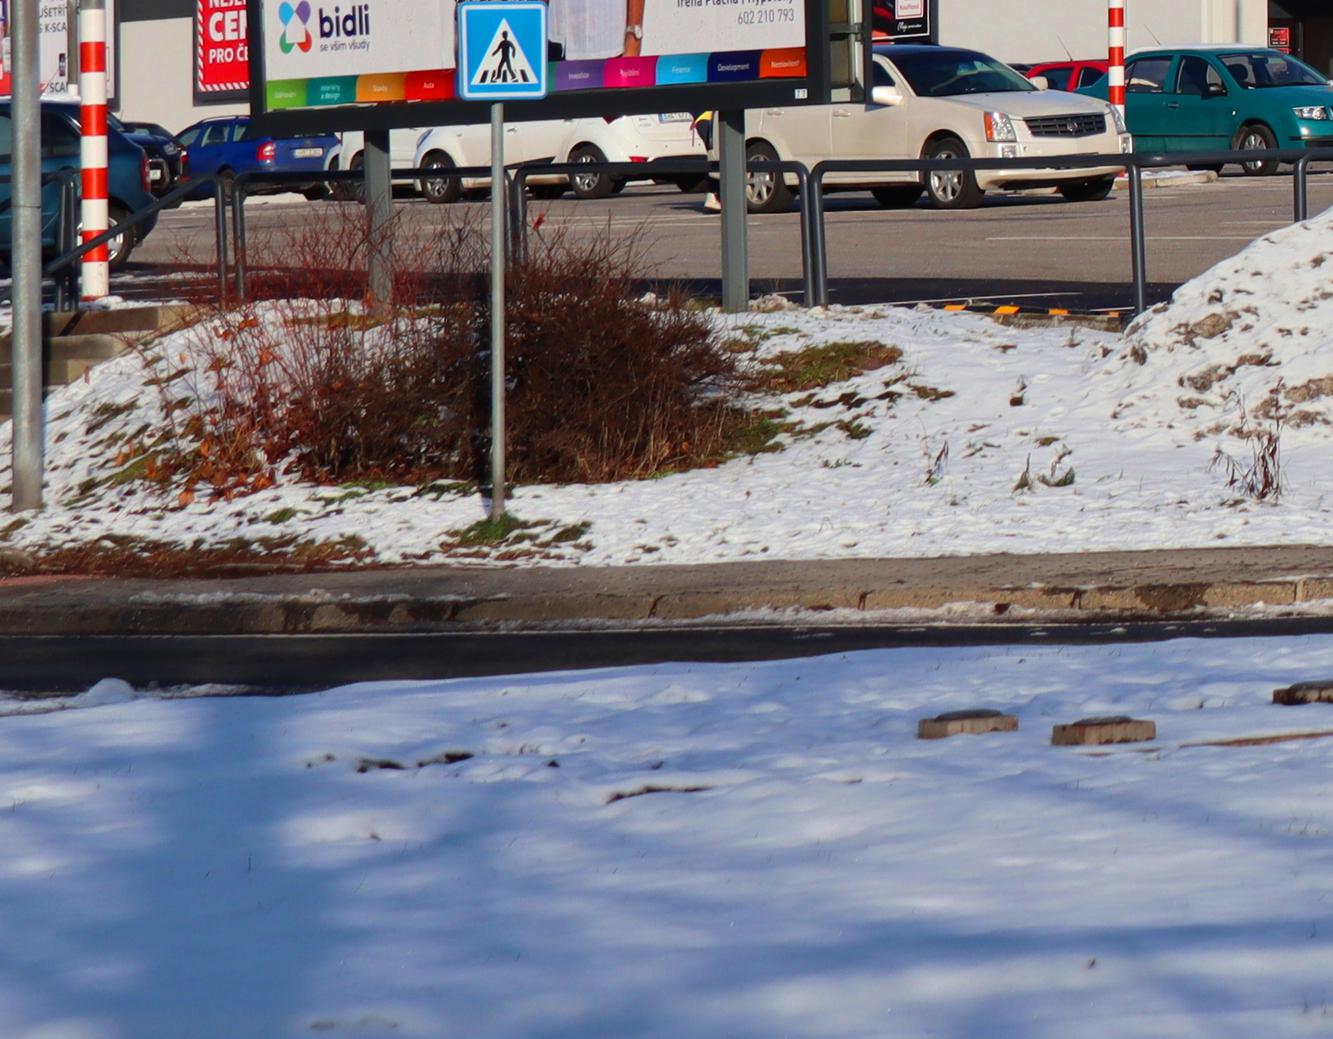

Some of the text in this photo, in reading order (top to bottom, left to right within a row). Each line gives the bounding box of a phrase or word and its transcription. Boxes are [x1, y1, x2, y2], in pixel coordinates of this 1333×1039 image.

[318, 3, 370, 39] bidli
[738, 8, 795, 25] 602 210 793
[209, 47, 234, 64] PRO
